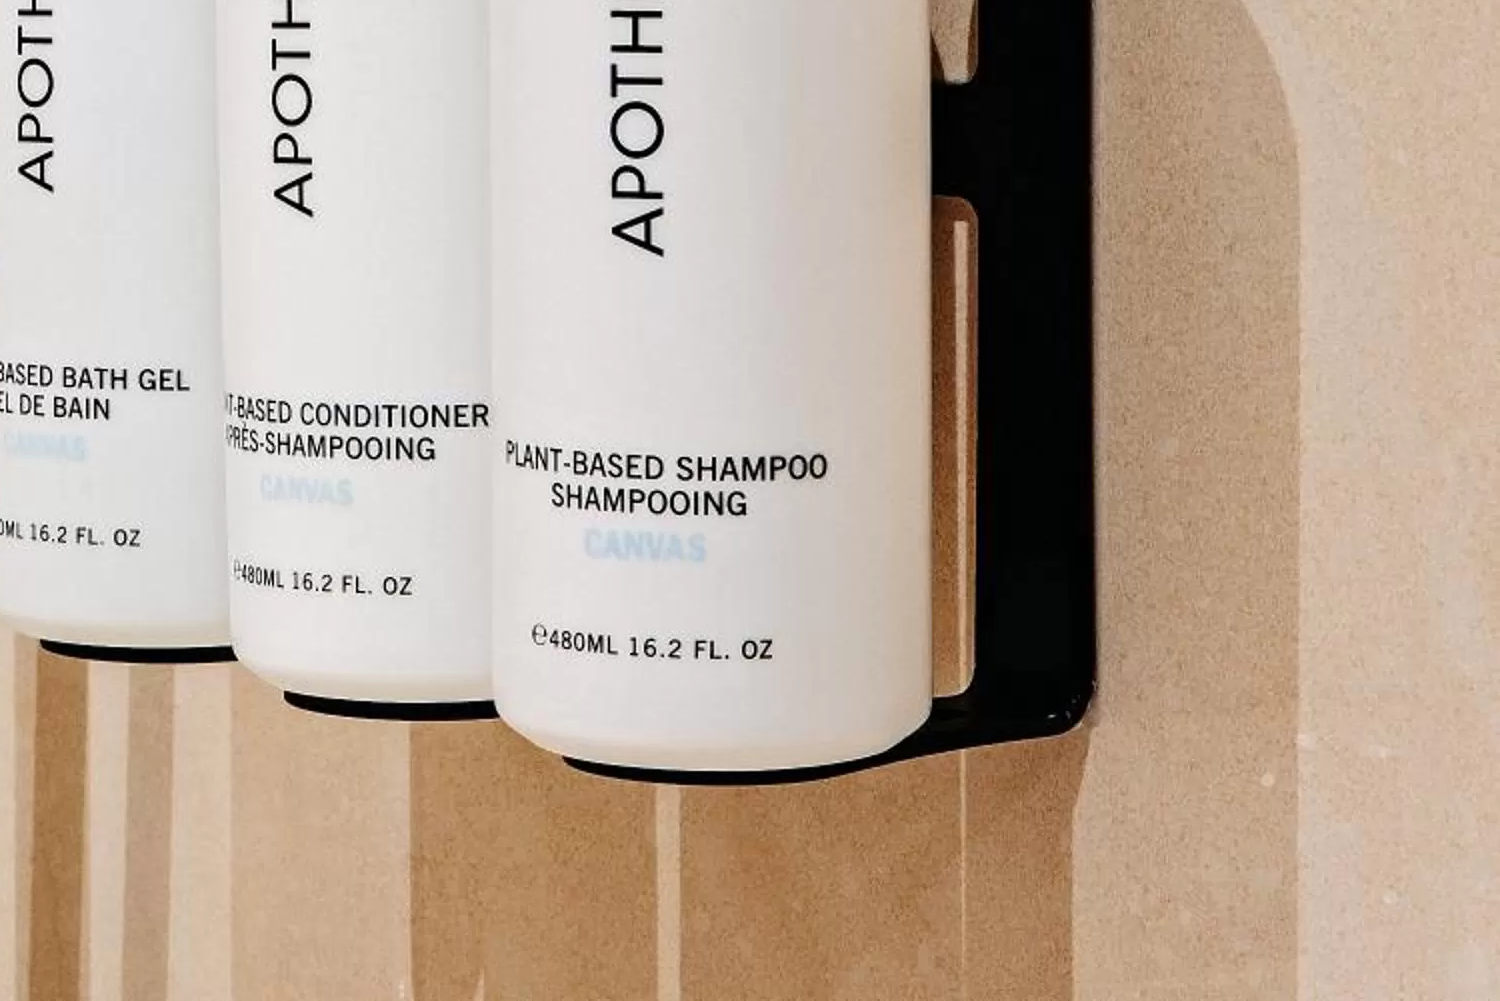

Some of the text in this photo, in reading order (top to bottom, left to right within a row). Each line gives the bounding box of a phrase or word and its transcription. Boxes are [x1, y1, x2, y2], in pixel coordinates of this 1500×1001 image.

[62, 366, 128, 391] BATH
[137, 368, 191, 392] GEL
[19, 392, 45, 417] DE
[53, 395, 111, 421] BAIN
[300, 401, 490, 429] CONDITIONER
[505, 439, 829, 482] PLANT-BASED SHAMPOO
[551, 482, 748, 517] SHAMPOOING
[30, 522, 68, 544] 16.2
[75, 526, 105, 546] FL.
[113, 528, 142, 548] OZ
[583, 527, 708, 563] CANVAS
[292, 571, 333, 593] 16.2
[341, 574, 373, 595] FL.
[382, 576, 413, 596] OZ
[629, 636, 683, 660] 16.2
[693, 639, 731, 661] FL.
[741, 638, 773, 660] OZ
